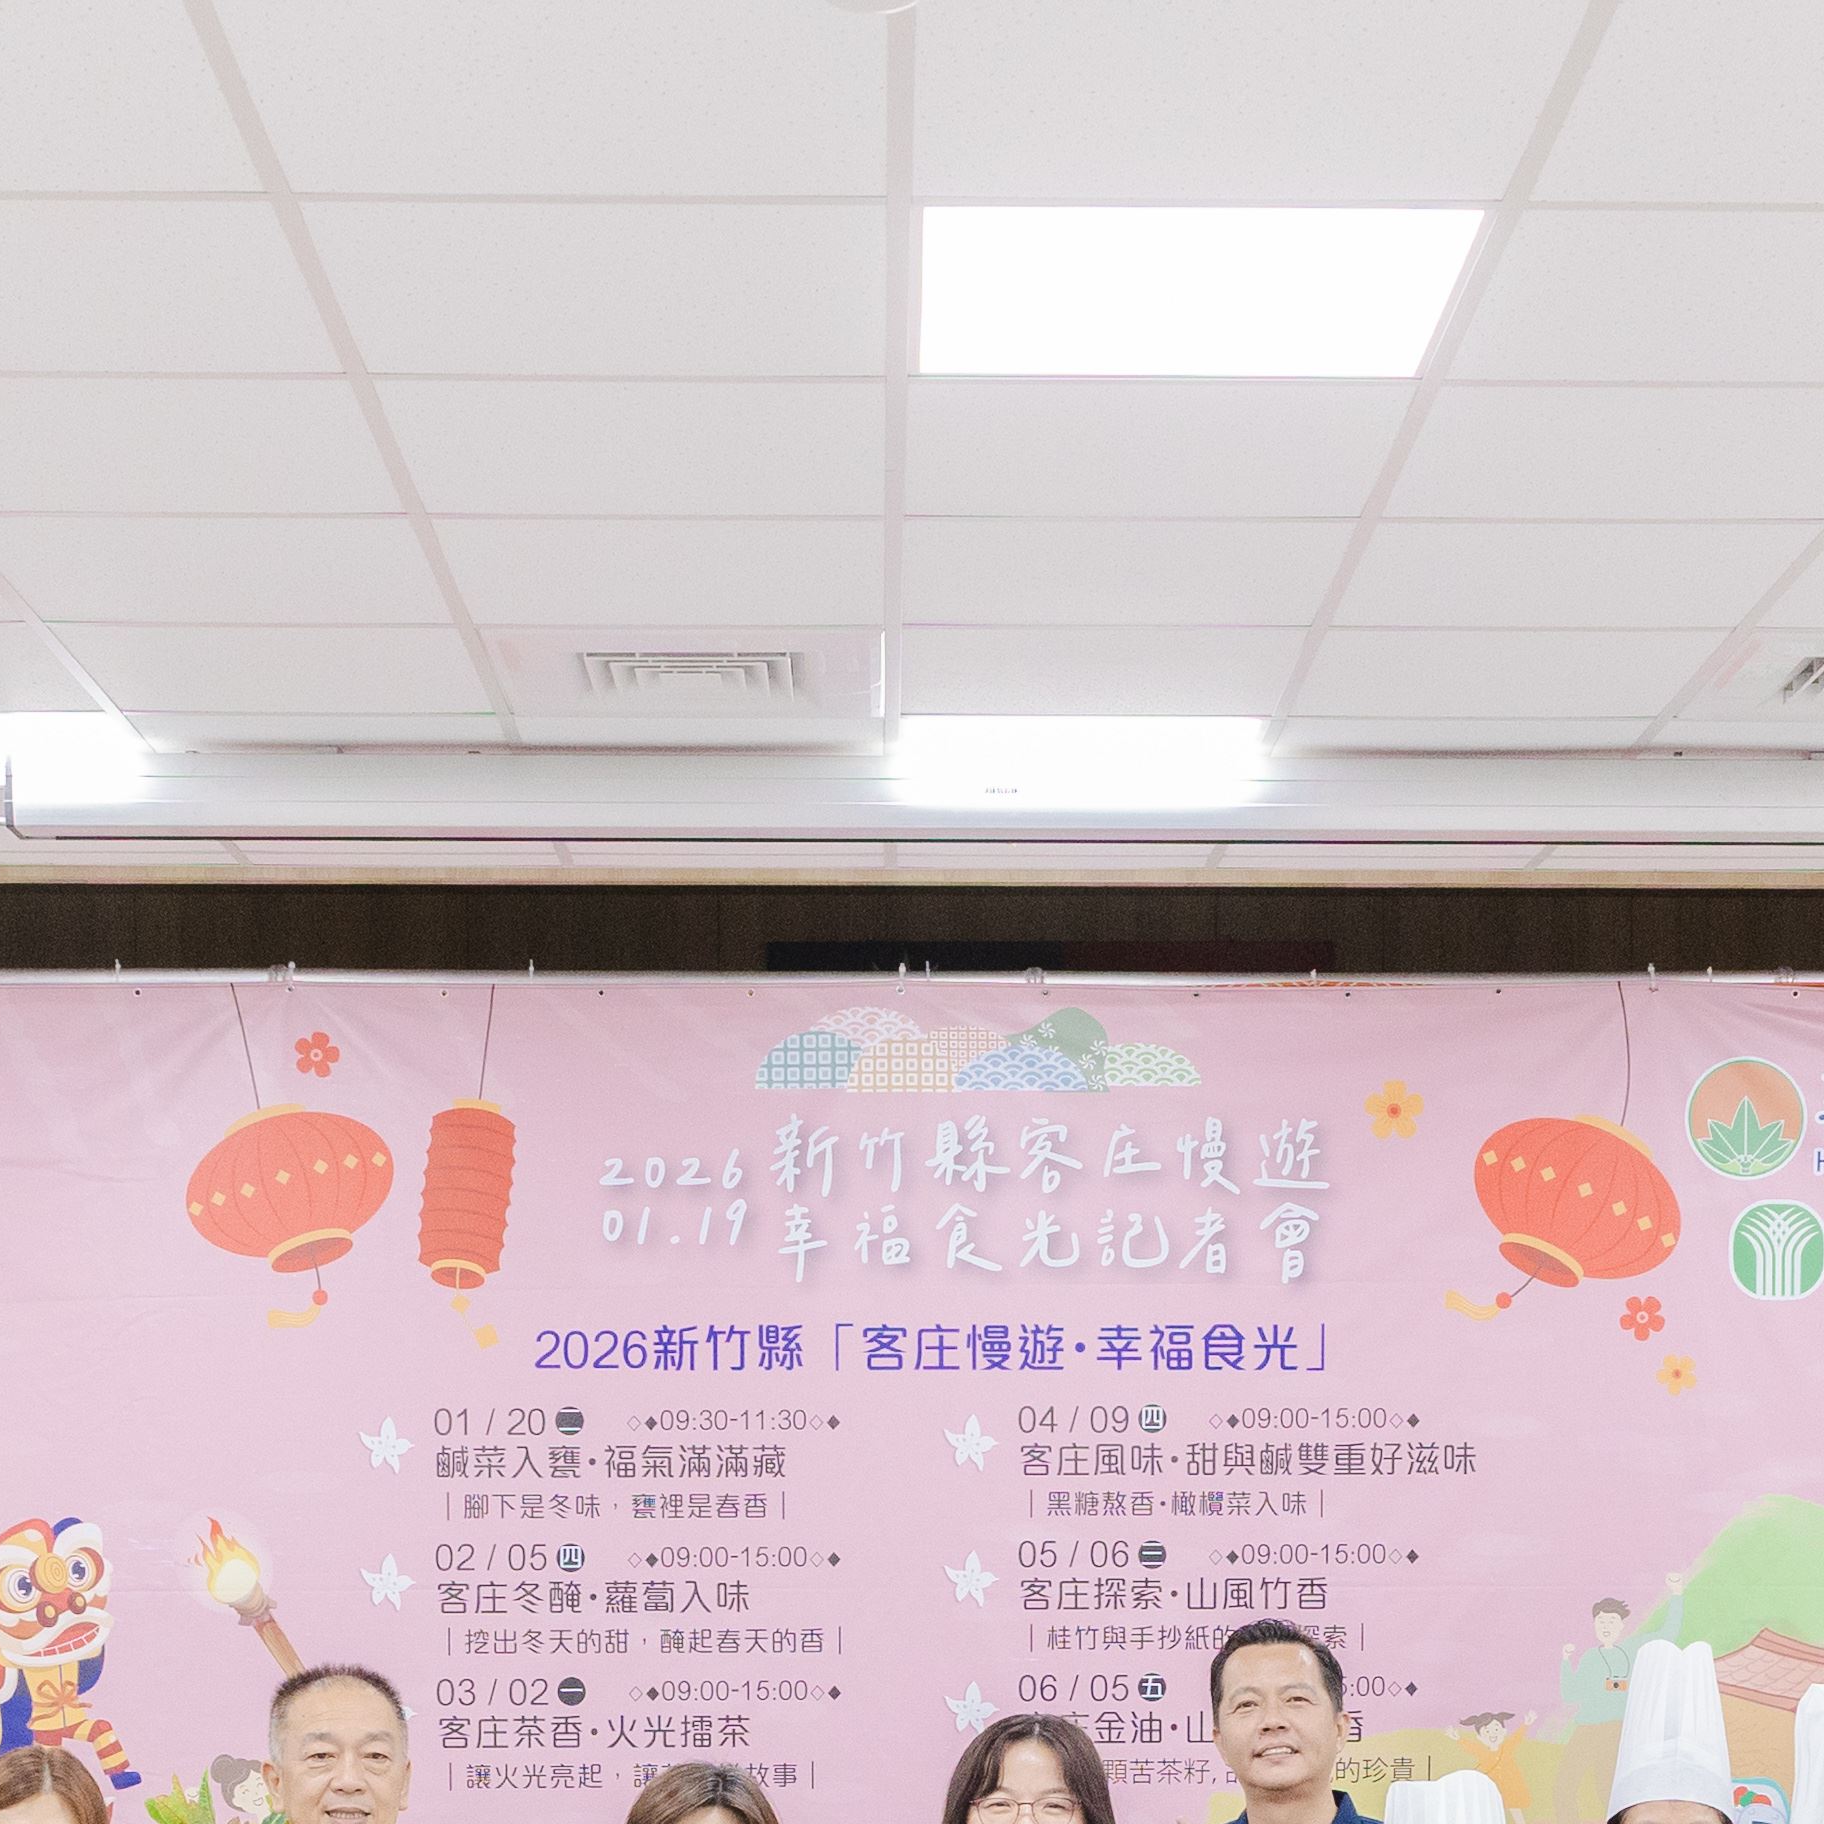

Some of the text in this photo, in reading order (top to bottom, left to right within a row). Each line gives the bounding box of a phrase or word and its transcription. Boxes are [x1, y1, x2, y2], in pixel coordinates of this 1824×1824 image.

[600, 1114, 1329, 1198] 2026 新竹縣客庄慢遊
[601, 1199, 1320, 1284] 01.19 幸福食光記者會
[434, 1408, 470, 1436] 01
[507, 1408, 546, 1436] 20
[660, 1409, 807, 1432] 09:30-11:30
[1018, 1405, 1058, 1433] 04
[1090, 1405, 1130, 1433] 09
[1140, 1406, 1165, 1431] 四
[1241, 1407, 1387, 1430] 09:00-15:00
[435, 1543, 475, 1571] 02
[508, 1543, 547, 1571] 05
[558, 1545, 583, 1570] 四
[660, 1546, 807, 1568] 09:00-15:00
[1018, 1540, 1058, 1569] 05
[1090, 1540, 1130, 1569] 06
[1241, 1543, 1387, 1565] 09:00-15:00
[436, 1678, 476, 1706] 03
[508, 1678, 549, 1706] 02
[661, 1679, 808, 1702] 09:00-15:00
[1018, 1674, 1058, 1702] 06
[1090, 1674, 1130, 1702] 05
[1140, 1675, 1165, 1700] 五
